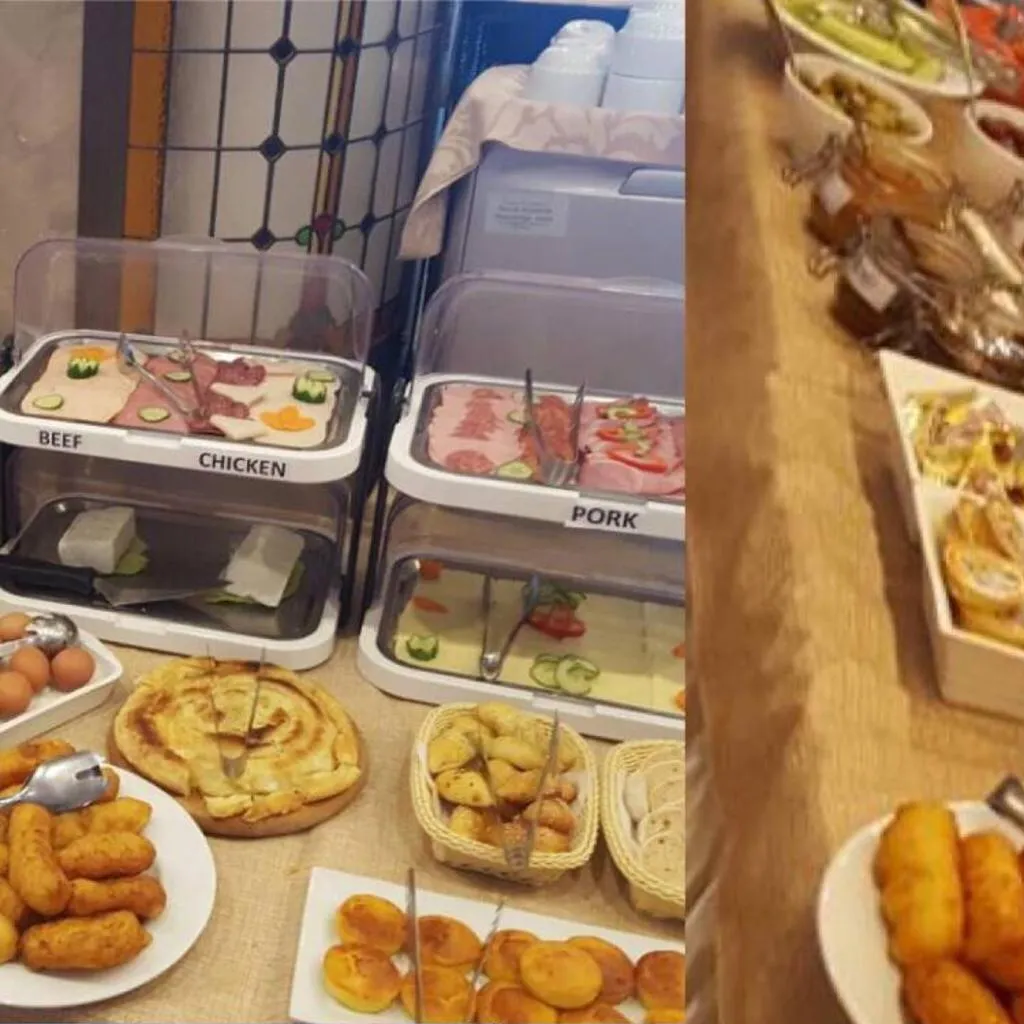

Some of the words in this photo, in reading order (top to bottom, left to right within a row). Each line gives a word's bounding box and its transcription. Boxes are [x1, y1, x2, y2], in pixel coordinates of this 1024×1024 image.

[38, 430, 82, 449] BEEF
[198, 452, 287, 477] CHICKEN
[572, 505, 639, 529] PORK
